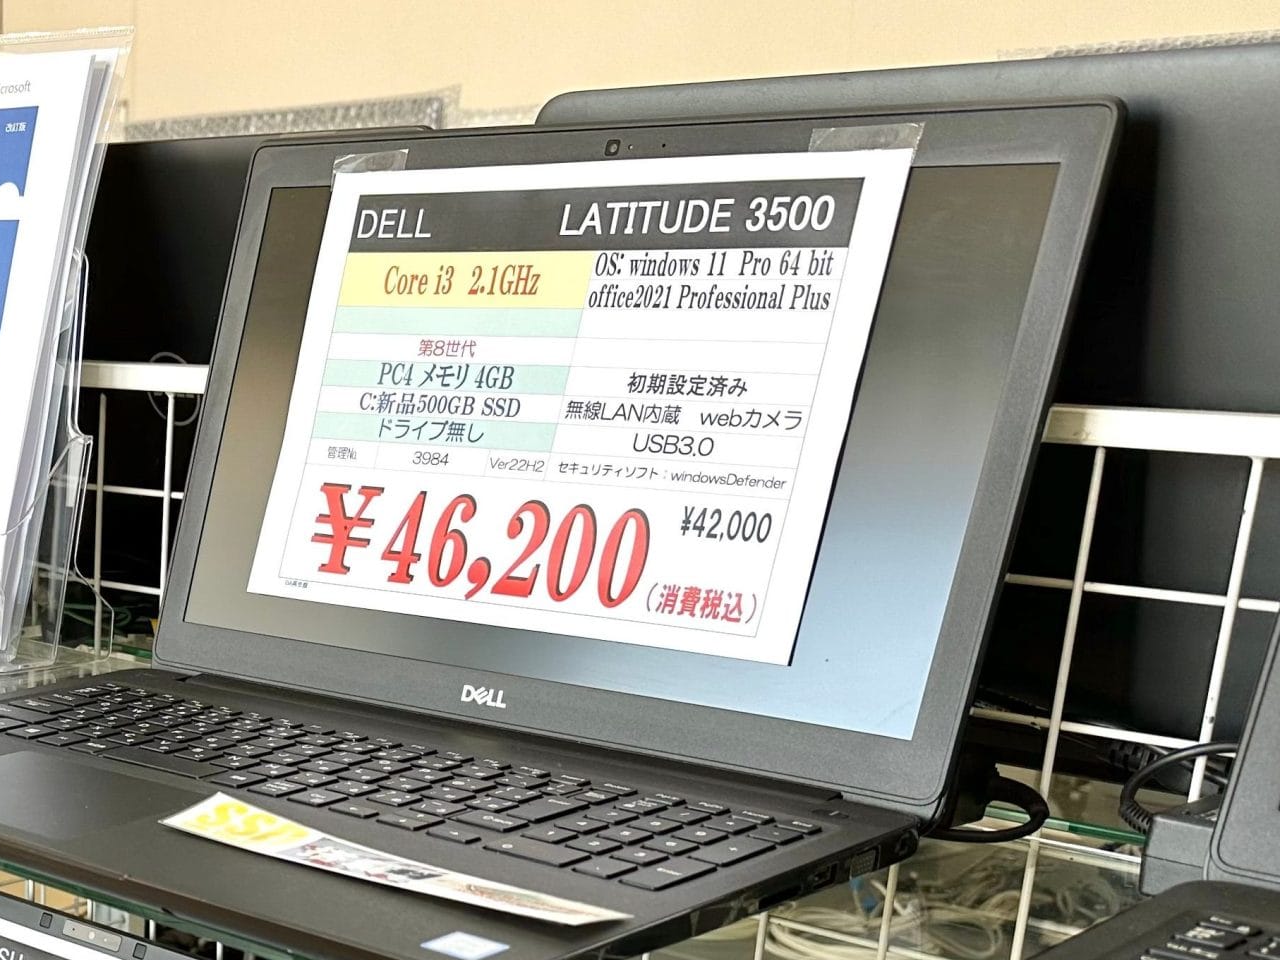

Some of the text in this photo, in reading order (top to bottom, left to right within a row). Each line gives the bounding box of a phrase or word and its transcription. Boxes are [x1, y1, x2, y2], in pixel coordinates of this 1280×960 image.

[357, 195, 835, 240] DELL LATITUDE 3500
[594, 251, 834, 279] OS: windows 11 Pro 64 bit
[383, 267, 541, 297] Core i3 2.1GHz
[587, 282, 831, 312] office2021 Professional Plus
[418, 339, 477, 359] 第8世代
[378, 362, 515, 390] PC4 メモリ 4GB
[627, 373, 749, 397] 初期設定済み
[359, 392, 522, 418] C:新品500GB SSD
[565, 400, 803, 431] 無線LAN内蔵 webカメラ
[378, 420, 486, 443] ドライブ無し
[633, 434, 715, 457] USB3.0
[412, 451, 450, 466] 3984
[490, 458, 545, 473] Ver22H2
[681, 506, 773, 544] ¥42,000
[311, 483, 651, 609] ¥46,200
[645, 583, 758, 625] （消費税込）
[460, 684, 507, 709] DELL
